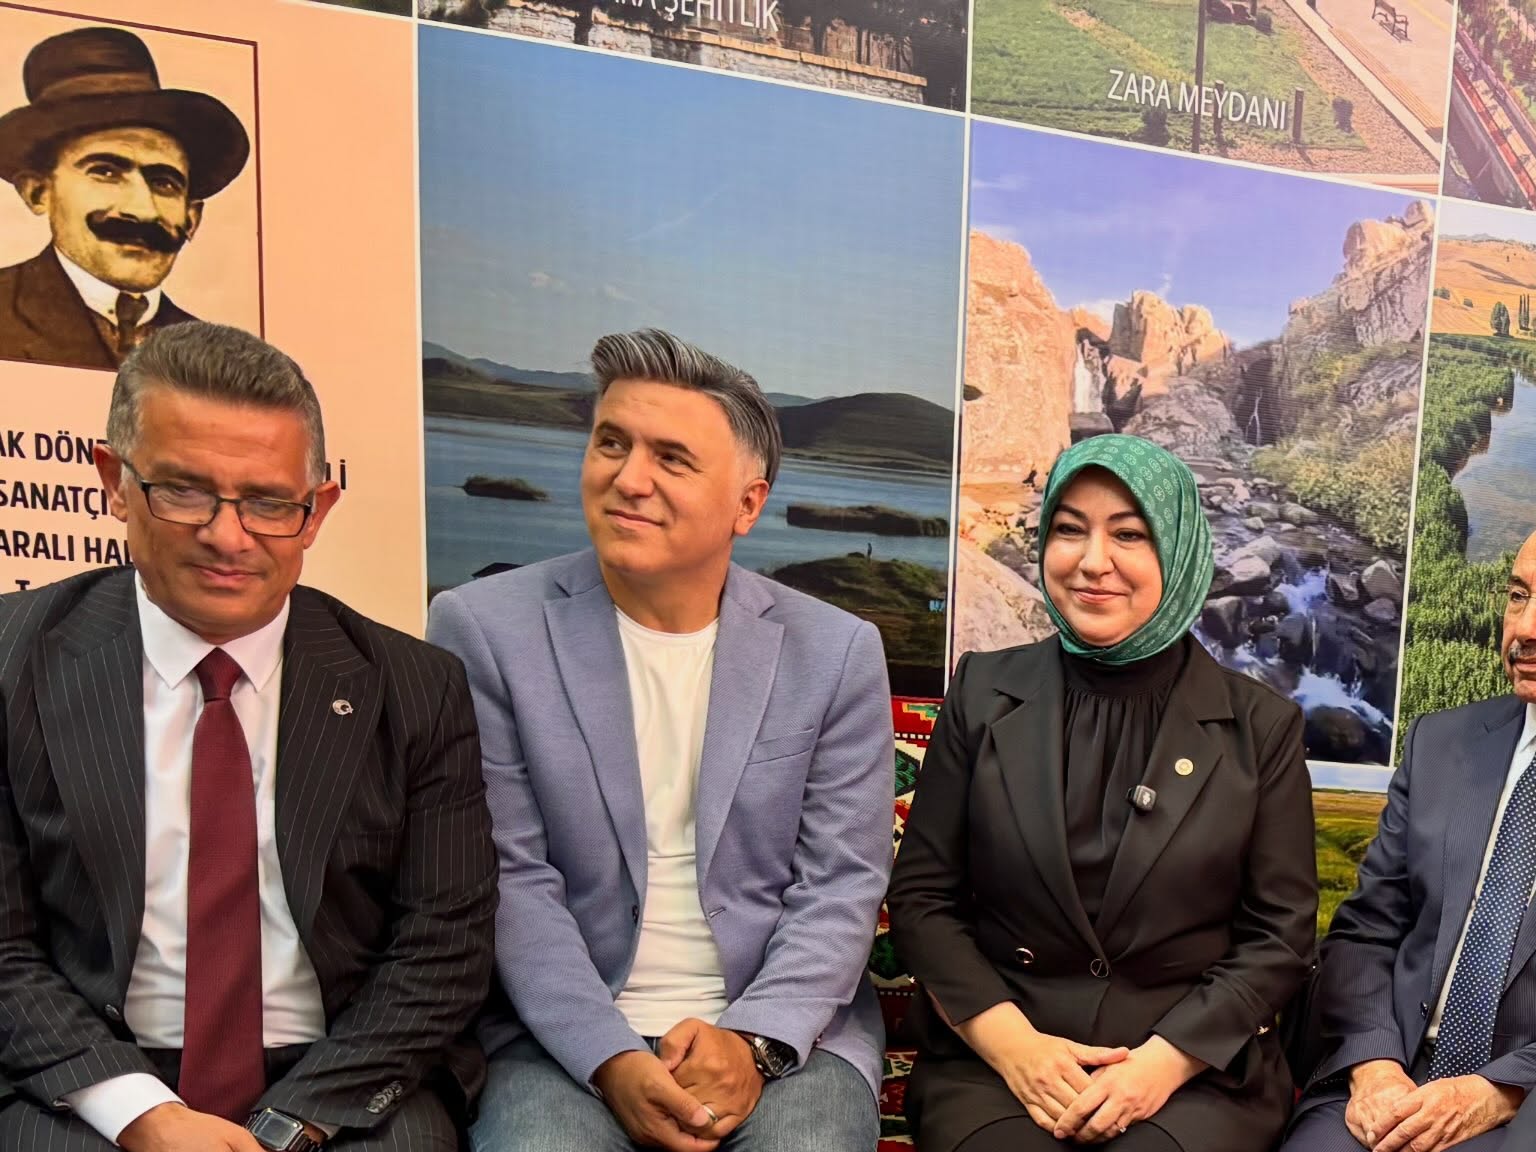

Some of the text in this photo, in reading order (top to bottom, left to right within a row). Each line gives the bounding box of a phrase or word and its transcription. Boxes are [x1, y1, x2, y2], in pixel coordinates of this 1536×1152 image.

[1107, 69, 1287, 130] ZARA MEYDANI
[34, 430, 108, 465] DÖN
